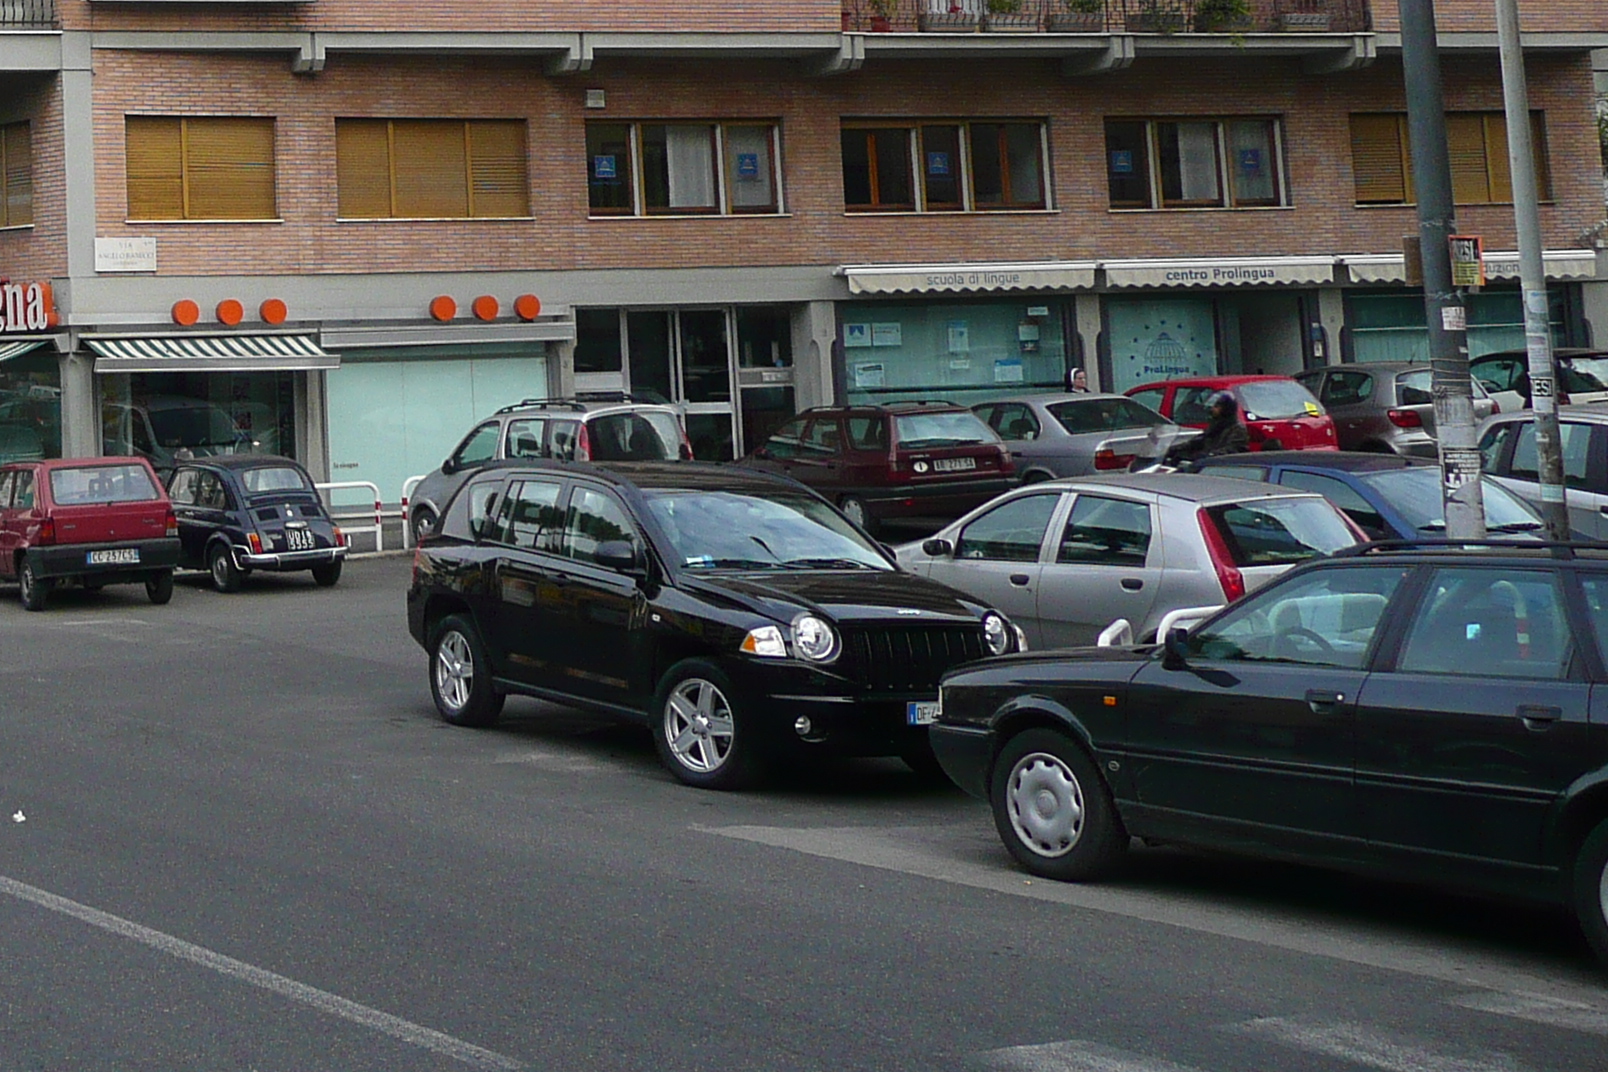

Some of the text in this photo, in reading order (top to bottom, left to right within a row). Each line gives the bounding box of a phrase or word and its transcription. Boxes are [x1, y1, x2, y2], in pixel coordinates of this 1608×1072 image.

[927, 272, 1020, 286] scuola di lingue
[1166, 268, 1275, 281] centro Prolingua
